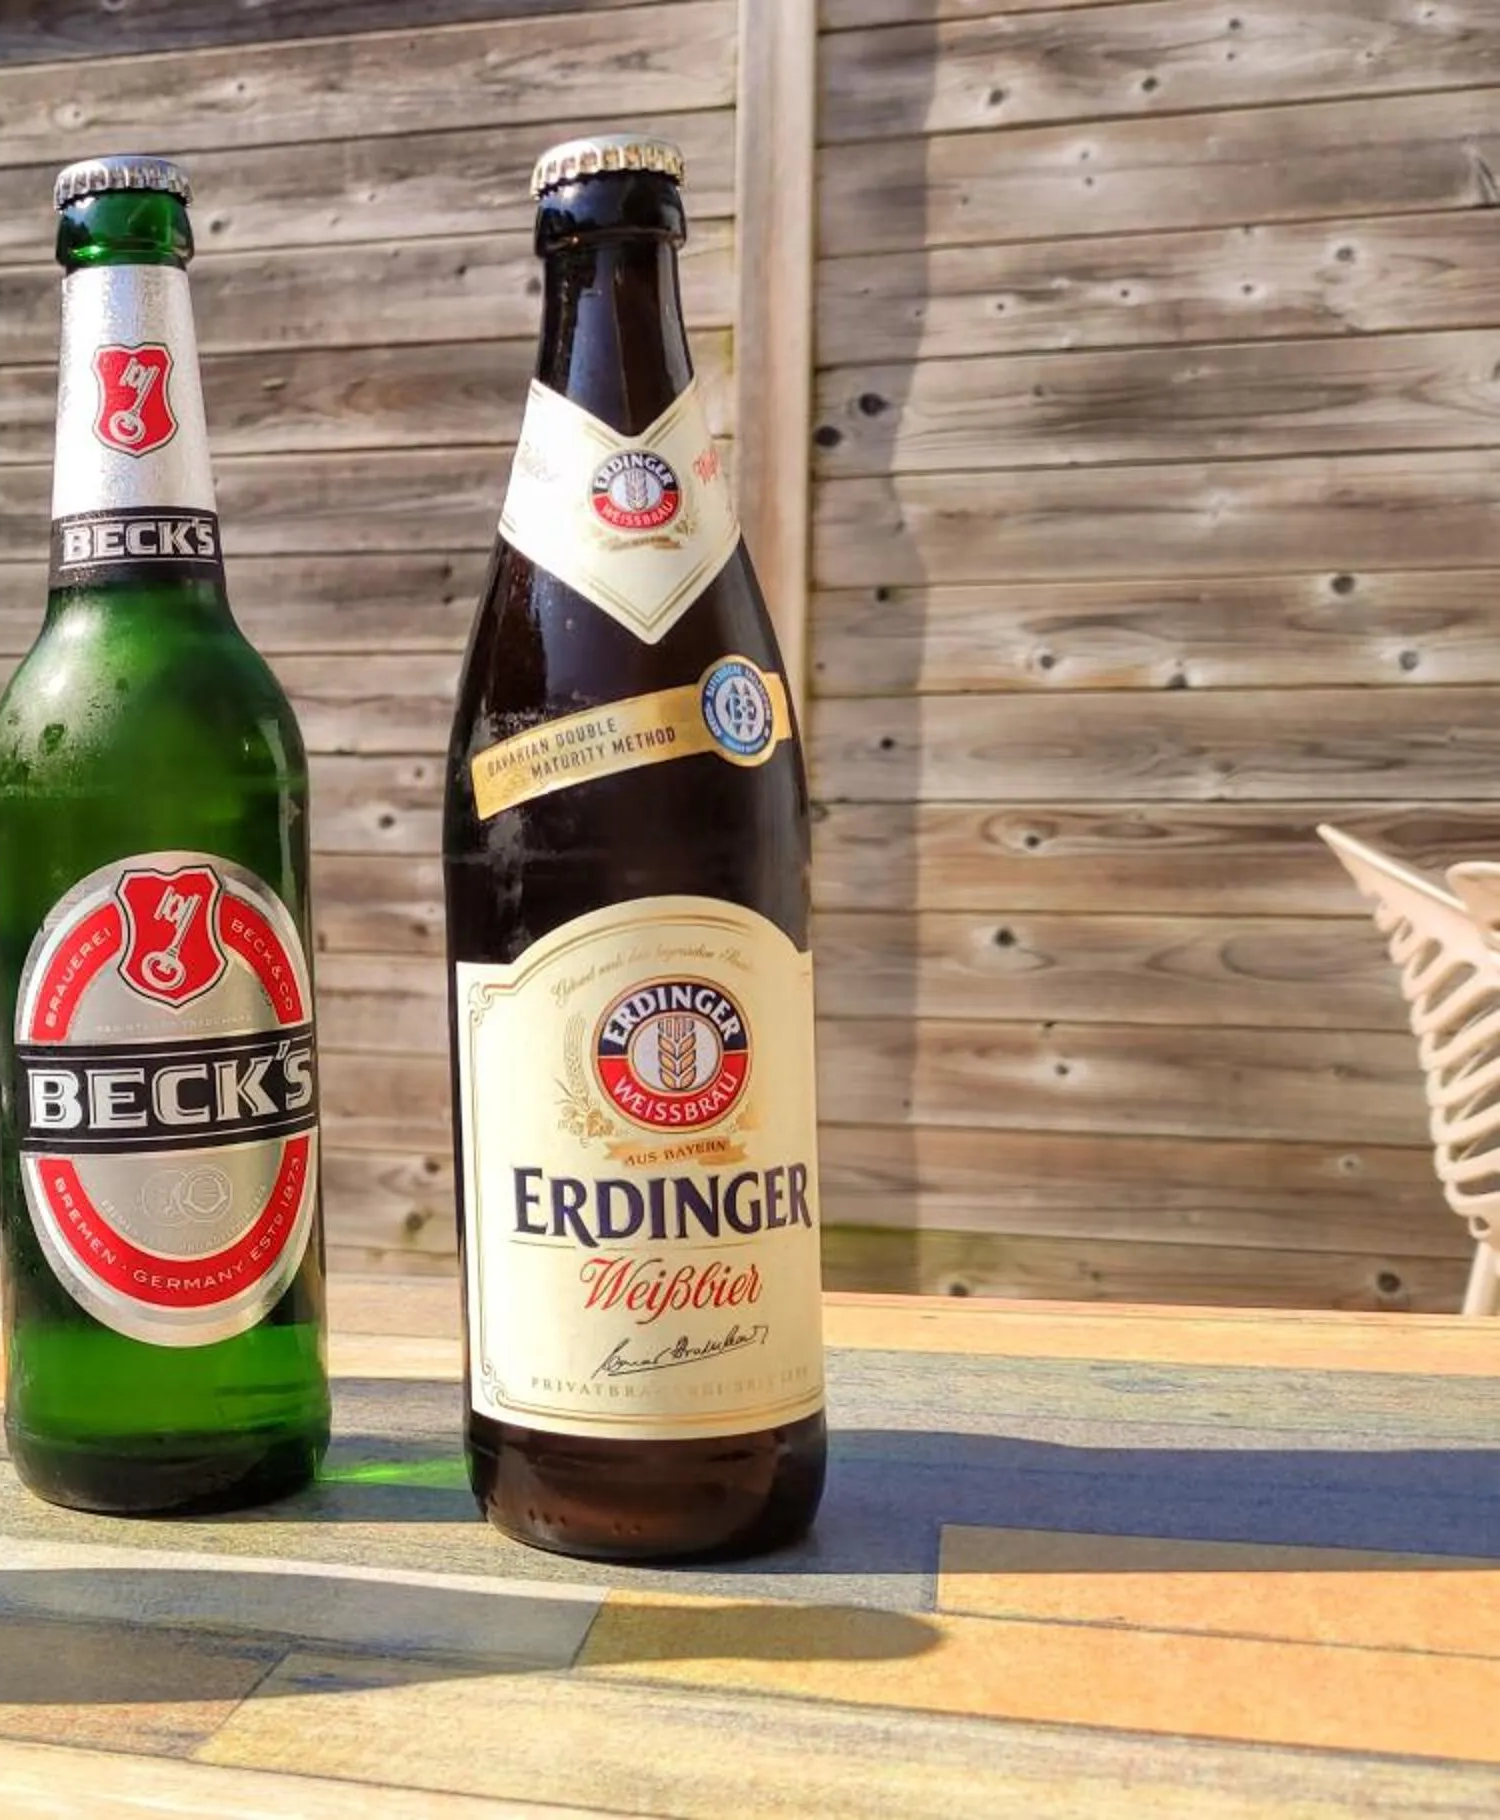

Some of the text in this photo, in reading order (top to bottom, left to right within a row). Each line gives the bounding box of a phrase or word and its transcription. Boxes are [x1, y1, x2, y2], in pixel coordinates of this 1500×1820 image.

[595, 454, 674, 488] ERDINGER
[63, 518, 215, 562] BECK'S
[531, 726, 677, 780] MATURITY METHOD
[555, 718, 617, 748] DOUBLE
[45, 927, 112, 1029] BRAUEREI
[602, 985, 741, 1046] ERDINGER
[26, 1040, 313, 1130] BECK'S
[625, 1152, 658, 1167] AUS
[54, 1177, 117, 1265] BREMEN
[133, 1260, 244, 1290] GERMANY
[513, 1162, 813, 1248] ERDINGER
[580, 1255, 762, 1325] Weißbier
